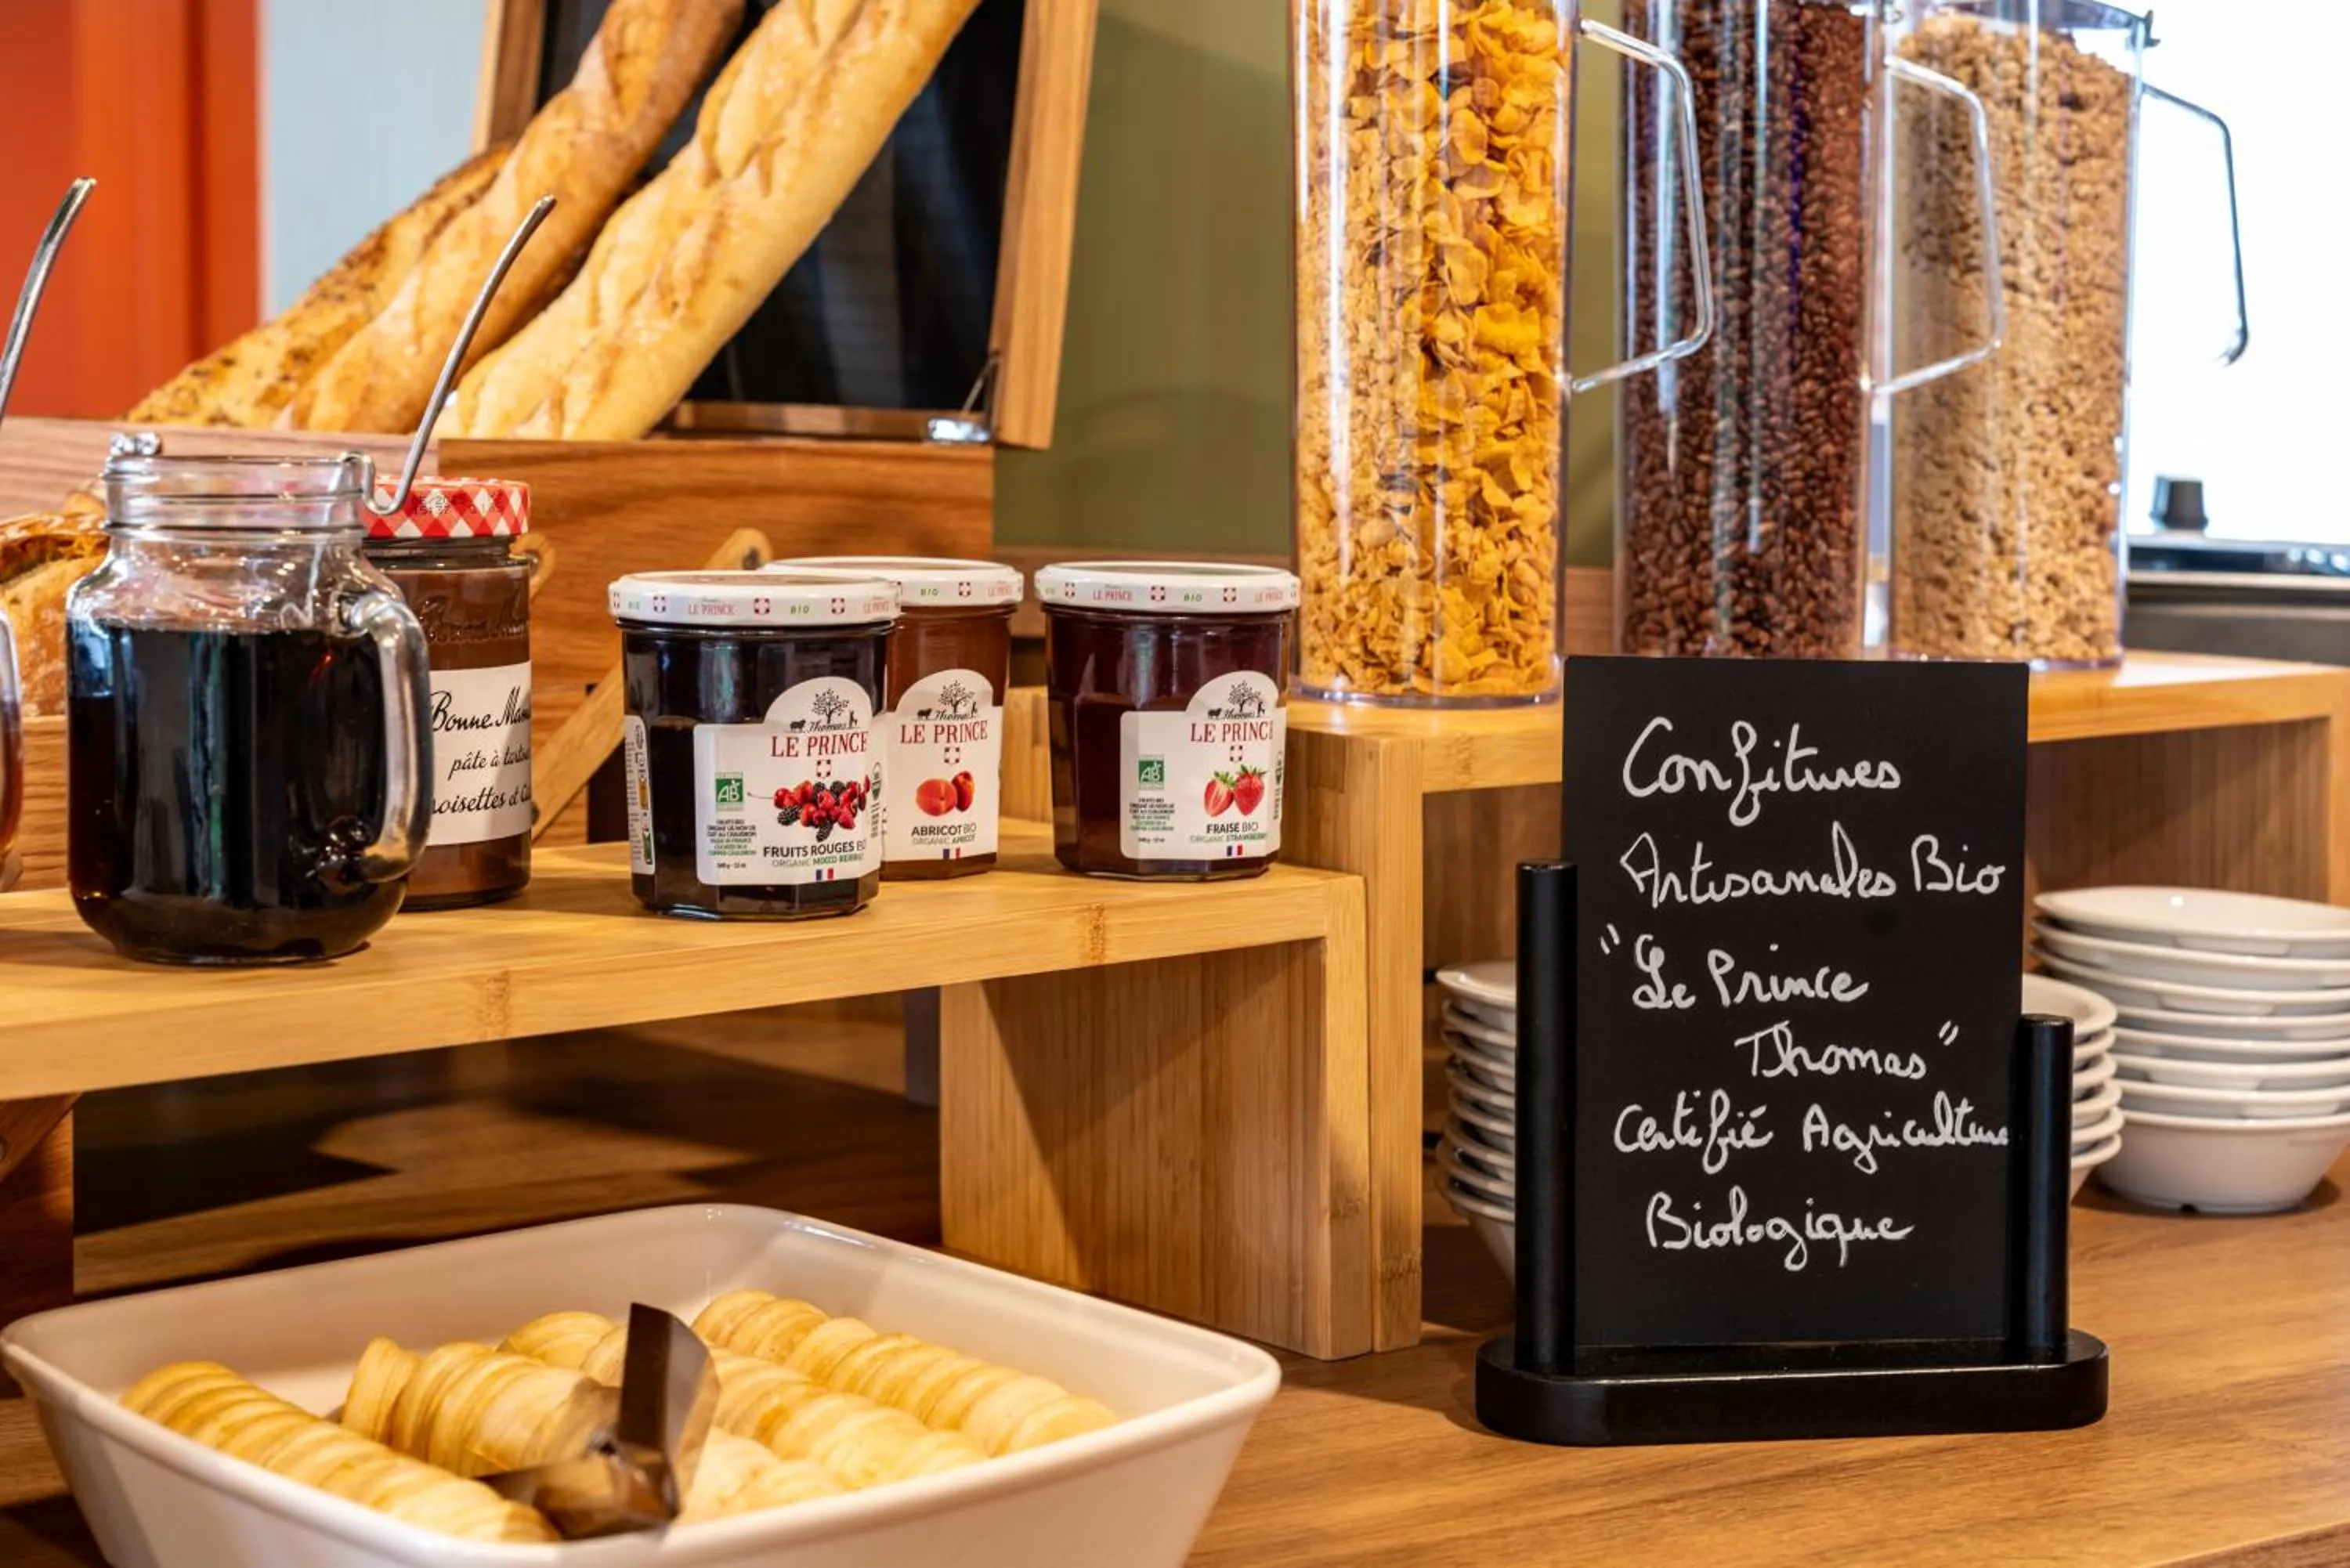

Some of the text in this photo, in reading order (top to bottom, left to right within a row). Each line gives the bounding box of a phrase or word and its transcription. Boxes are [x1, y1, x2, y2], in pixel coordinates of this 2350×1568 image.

[1104, 591, 1133, 601] PRINCE
[790, 605, 809, 614] BIO
[431, 690, 493, 732] Bonne
[900, 720, 989, 744] LE PRINCE
[1190, 723, 1216, 743] LE
[771, 736, 799, 758] LE
[447, 750, 486, 782] pâte
[490, 750, 501, 768] à
[1622, 716, 1902, 826] Confitures
[911, 824, 962, 836] ABRICOT
[1206, 822, 1240, 834] FRAISE
[763, 846, 808, 858] FRUITS
[811, 841, 855, 856] ROUGES
[1619, 819, 2007, 909] Artisanales Bio
[1707, 944, 1870, 1008] Prince
[1614, 1089, 1774, 1175] Certifié
[1646, 1185, 1914, 1272] Biologique
